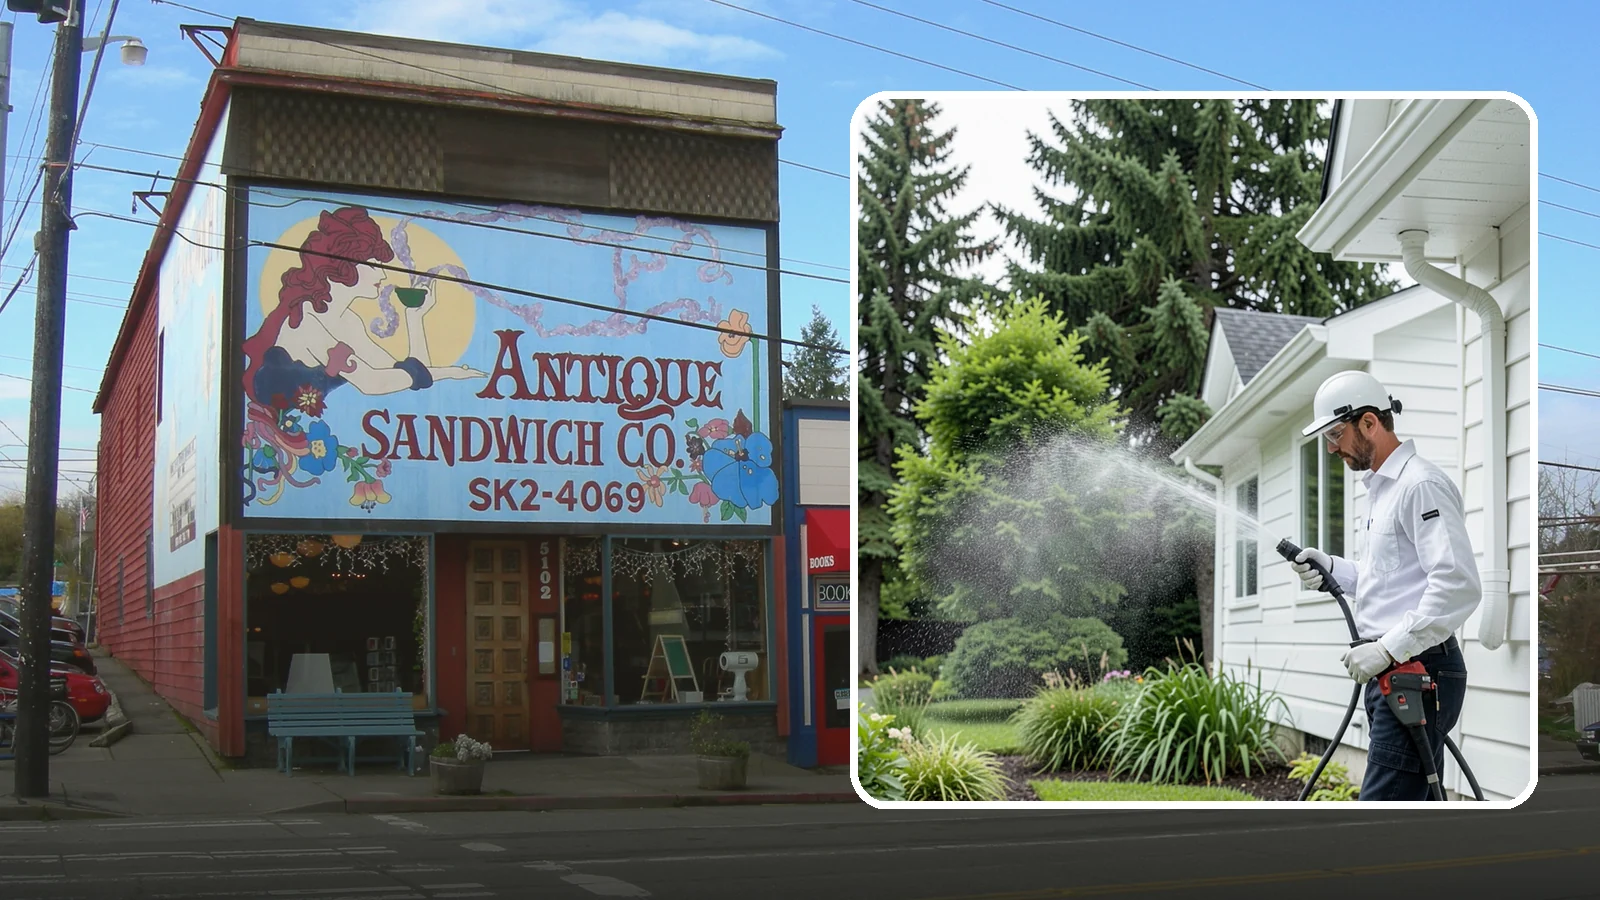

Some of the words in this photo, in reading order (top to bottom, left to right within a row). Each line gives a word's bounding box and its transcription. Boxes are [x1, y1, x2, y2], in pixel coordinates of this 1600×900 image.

[476, 329, 724, 421] ANTIQUE
[361, 408, 604, 467] SANDWICH
[617, 420, 685, 468] CO.
[468, 476, 645, 513] SK2-4069
[540, 541, 552, 600] 5102
[810, 555, 834, 569] BOOKS
